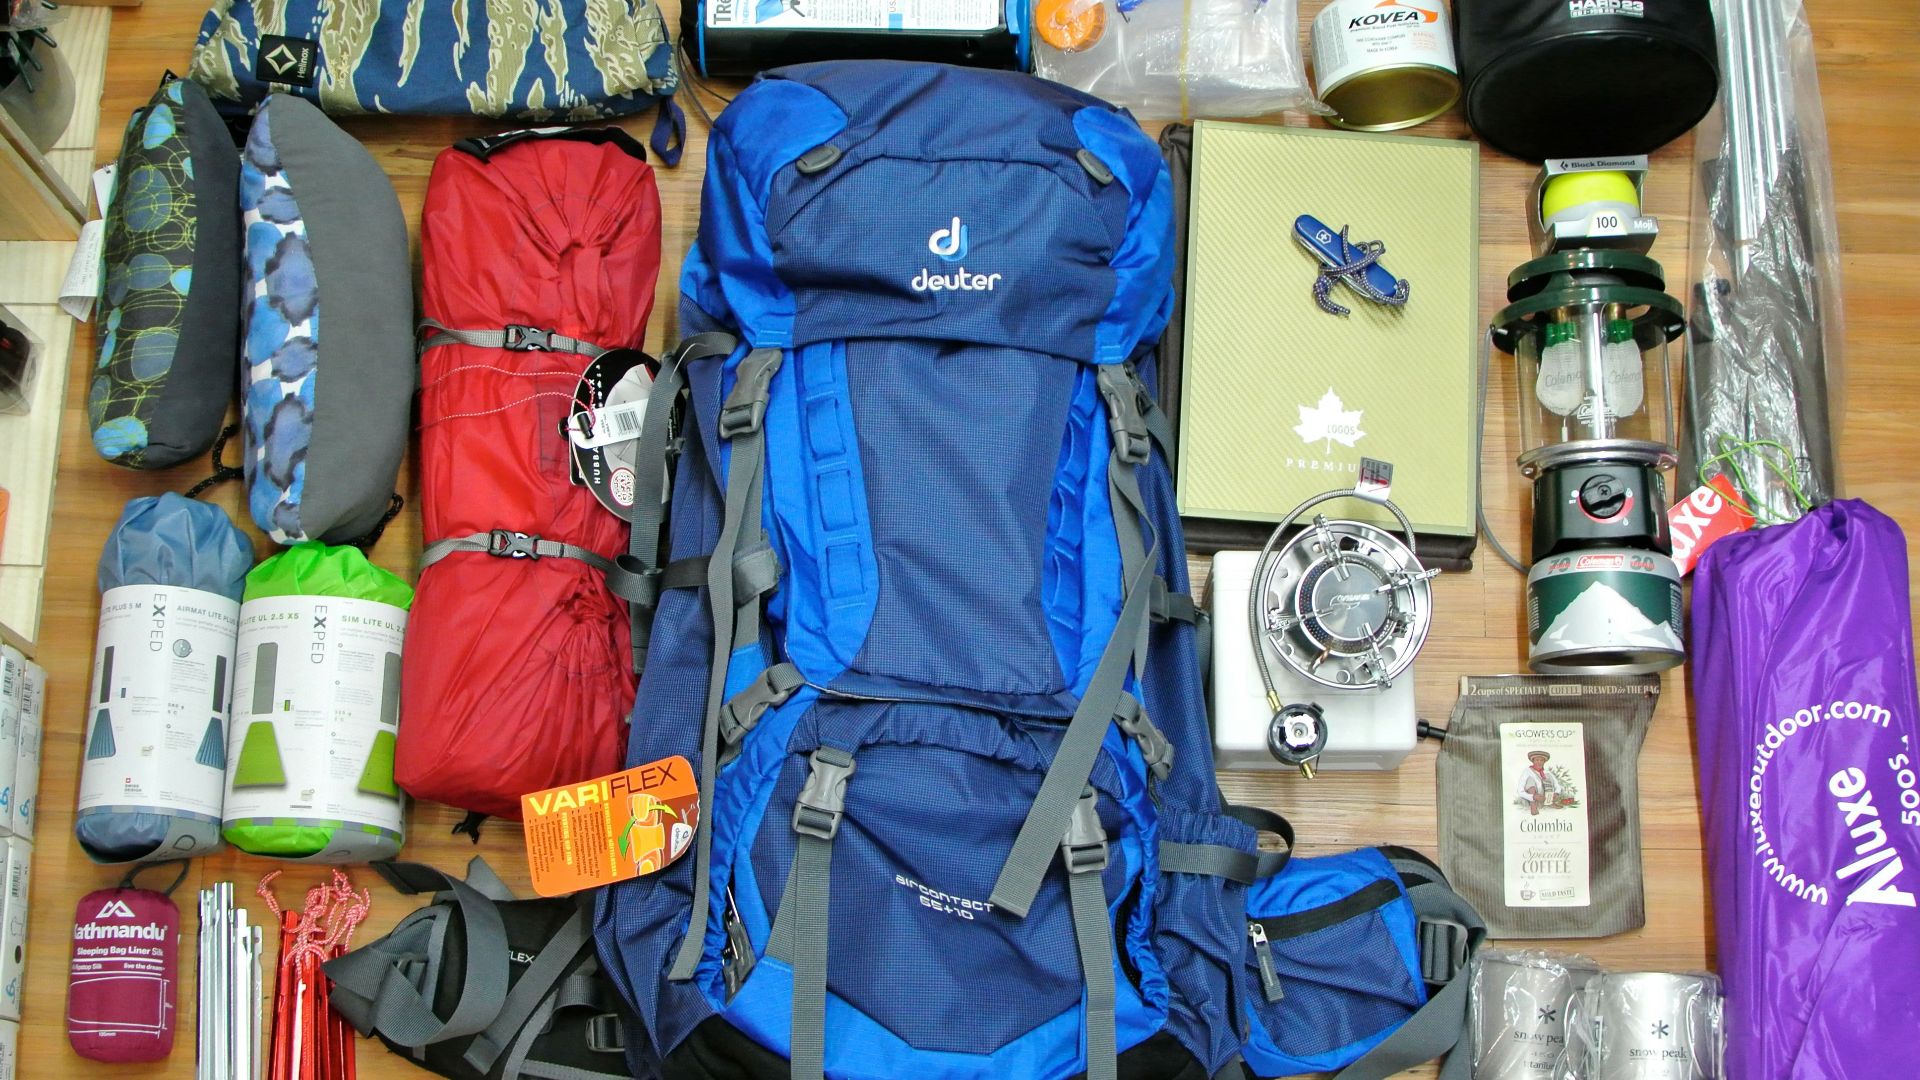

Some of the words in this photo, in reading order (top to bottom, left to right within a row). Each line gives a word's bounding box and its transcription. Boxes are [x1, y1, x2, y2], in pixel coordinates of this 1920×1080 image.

[1348, 11, 1419, 29] KOVEA
[297, 47, 309, 79] Helinox
[1597, 160, 1636, 168] Diamond
[1596, 216, 1618, 229] 100
[1633, 219, 1653, 230] Moji
[911, 266, 1002, 291] deuter
[1327, 424, 1356, 436] LOGOS
[1286, 458, 1357, 472] PREMIU
[1669, 486, 1723, 577] uxe
[177, 605, 207, 616] AIRMAT
[208, 611, 222, 620] LITE
[271, 613, 284, 621] 2.5
[288, 612, 300, 620] XS
[149, 593, 167, 652] EXPED
[341, 615, 359, 624] SIM
[363, 618, 382, 628] LITE
[385, 622, 395, 630] UL
[311, 605, 328, 664] EXPED
[1470, 684, 1477, 696] 2
[1477, 688, 1495, 697] cups
[1504, 686, 1548, 696] SPECIALTY
[1583, 685, 1617, 695] BREWED
[1626, 685, 1643, 694] THE
[528, 762, 677, 816] VARIFLEX
[1750, 701, 1892, 906] www.luxeoutdoor.com
[1520, 818, 1573, 833] Colombia
[1522, 846, 1572, 863] Specialty
[1522, 860, 1572, 874] COFFEE
[895, 874, 994, 912] aircontact
[74, 922, 166, 941] athmandu
[77, 947, 108, 957] Sleeping
[110, 946, 126, 956] Bag
[128, 946, 151, 955] Liner
[508, 950, 535, 963] LEX
[1514, 1031, 1544, 1041] snw
[1546, 1035, 1565, 1046] pea
[1630, 1048, 1656, 1057] snow
[1662, 1046, 1687, 1061] peak
